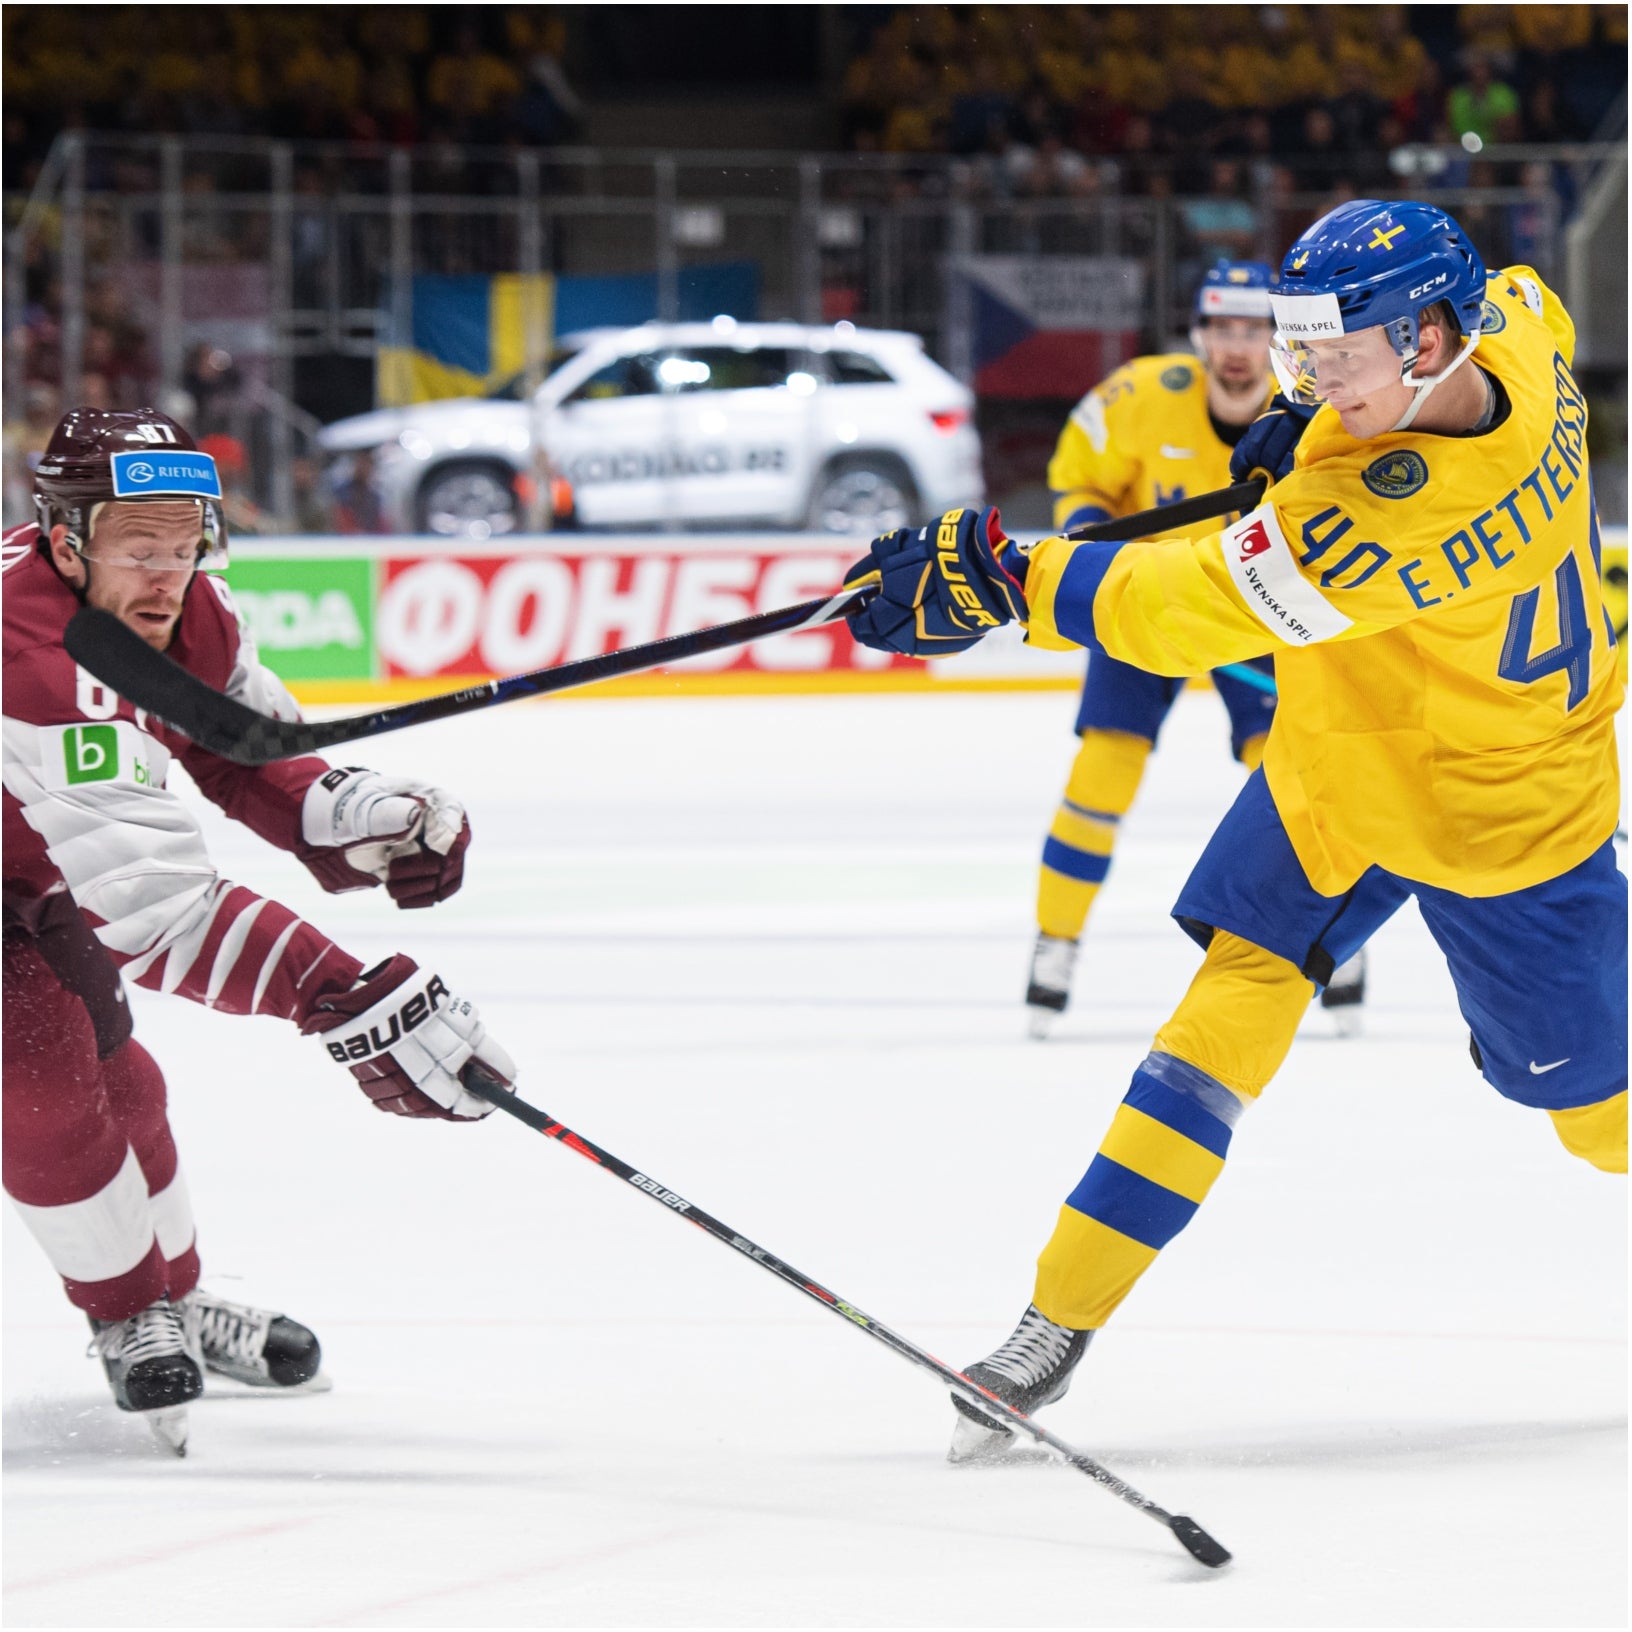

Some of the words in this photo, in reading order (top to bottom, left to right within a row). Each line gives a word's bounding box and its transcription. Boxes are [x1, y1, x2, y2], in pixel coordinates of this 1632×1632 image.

[1409, 272, 1447, 300] CCM
[1312, 321, 1336, 332] SPEL
[136, 424, 176, 444] 87
[937, 508, 1000, 627] BAUER
[1299, 505, 1393, 589] 40
[1245, 567, 1287, 620] SVENSKA
[1286, 618, 1313, 641] SPEL
[326, 974, 450, 1062] BAUER
[628, 1173, 692, 1213] BAUER
